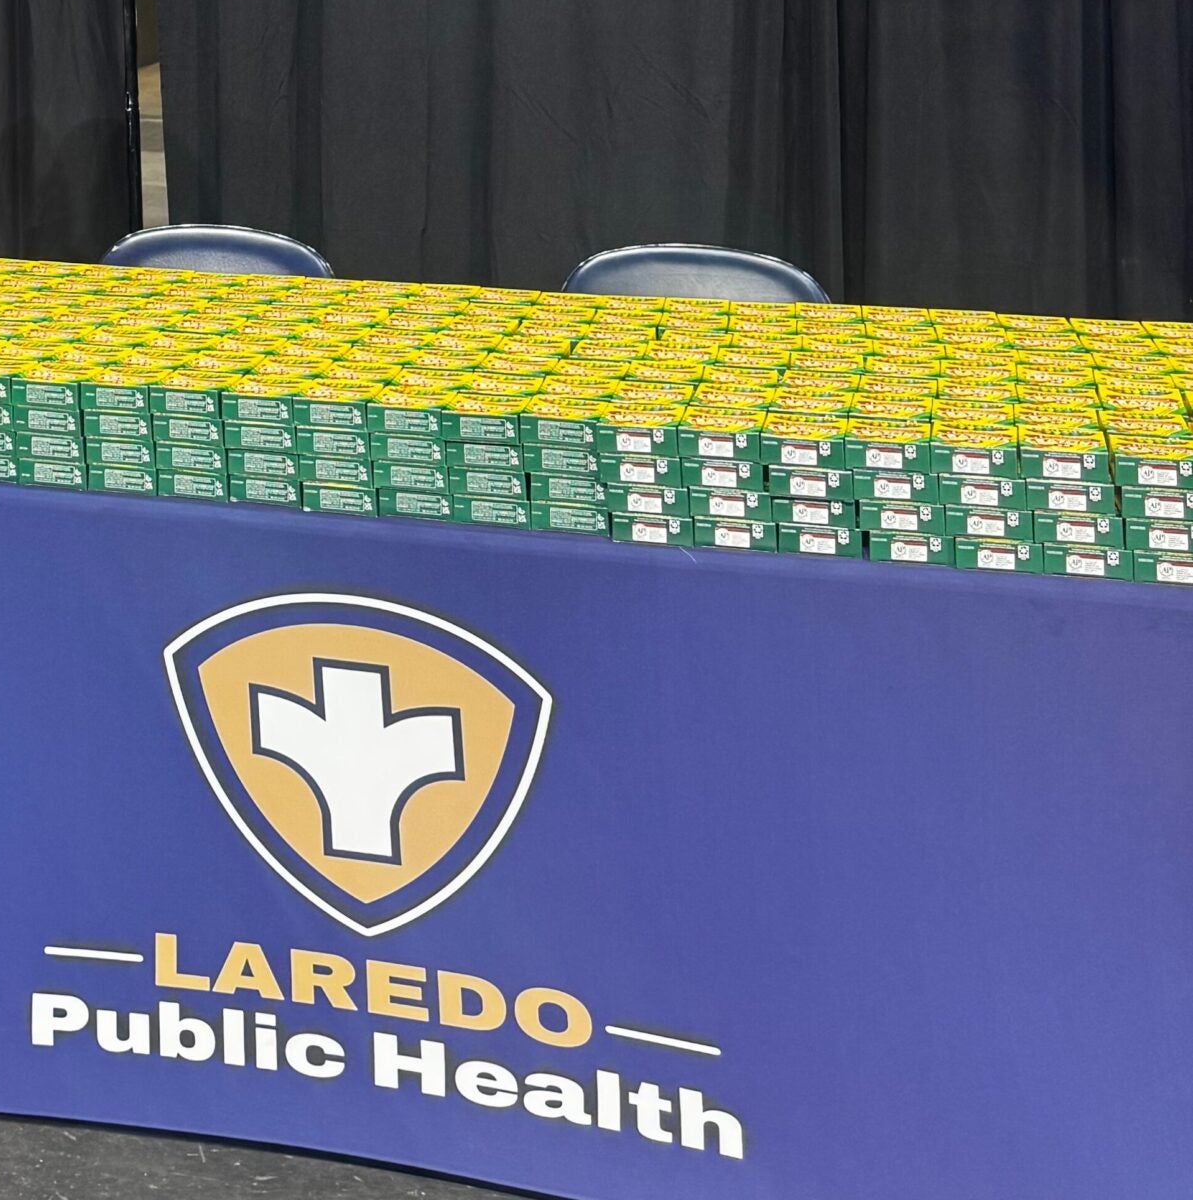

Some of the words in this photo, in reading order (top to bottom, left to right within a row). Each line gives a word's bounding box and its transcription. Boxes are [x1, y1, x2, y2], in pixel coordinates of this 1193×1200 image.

[154, 932, 593, 1047] LAREDO
[30, 992, 346, 1079] Public
[372, 1031, 745, 1160] Health
